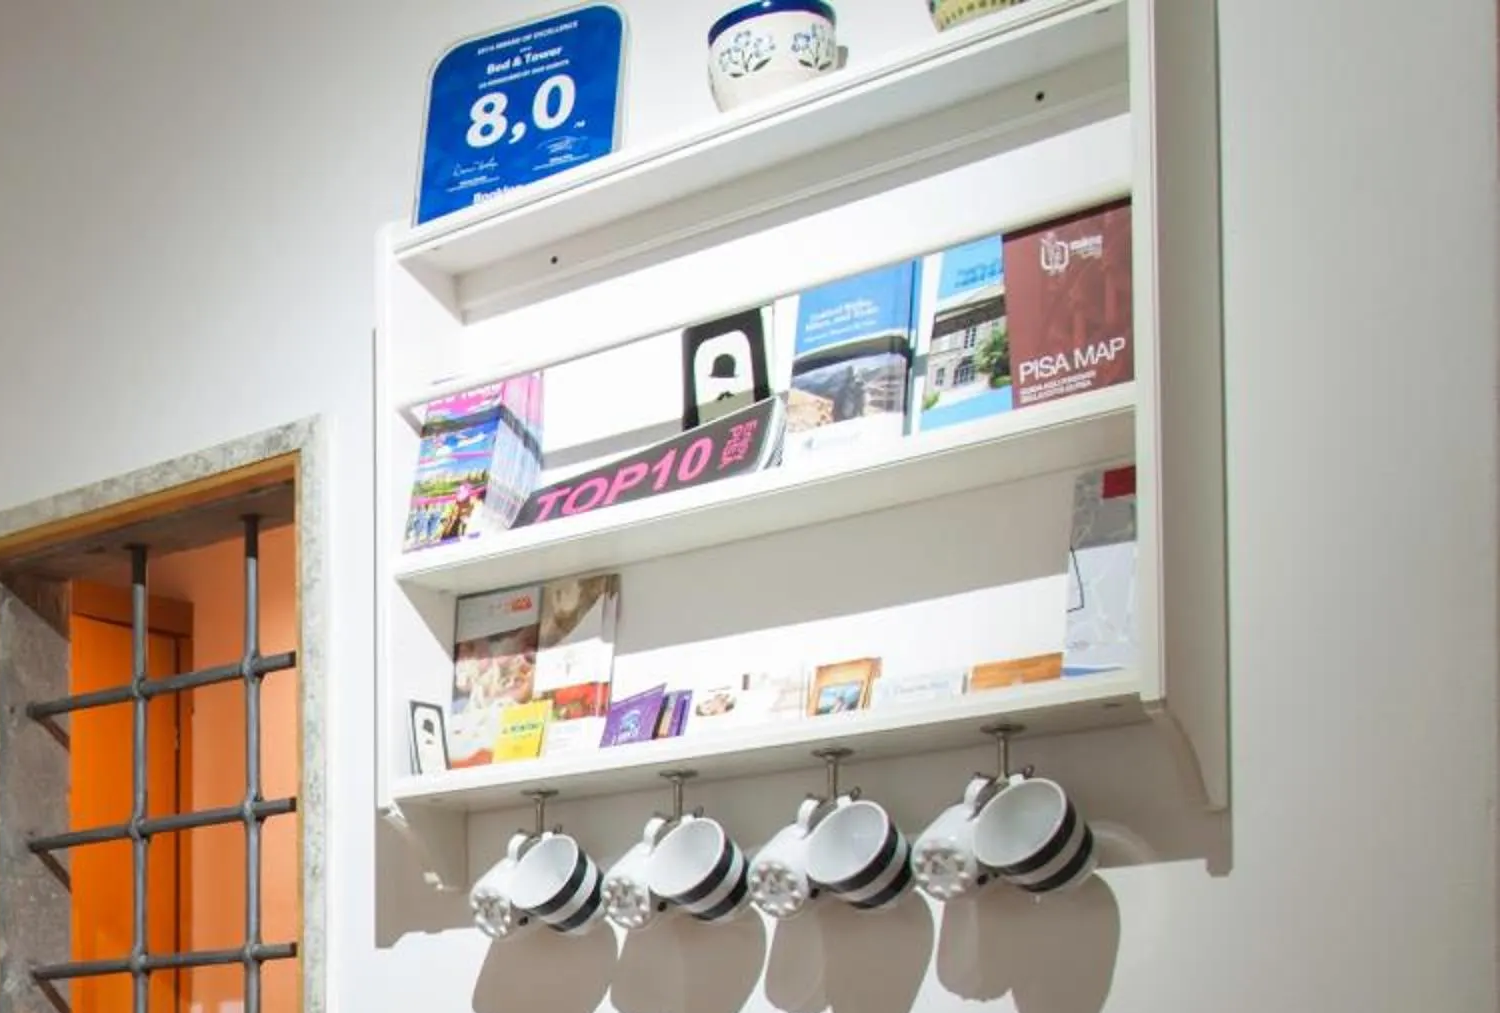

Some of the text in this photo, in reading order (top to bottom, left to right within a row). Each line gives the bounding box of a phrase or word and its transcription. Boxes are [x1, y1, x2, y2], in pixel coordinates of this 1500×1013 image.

[487, 58, 511, 75] Bed
[524, 46, 563, 64] Tower
[466, 73, 577, 149] 8,0
[1019, 352, 1071, 384] PISA
[1073, 337, 1126, 369] MAP
